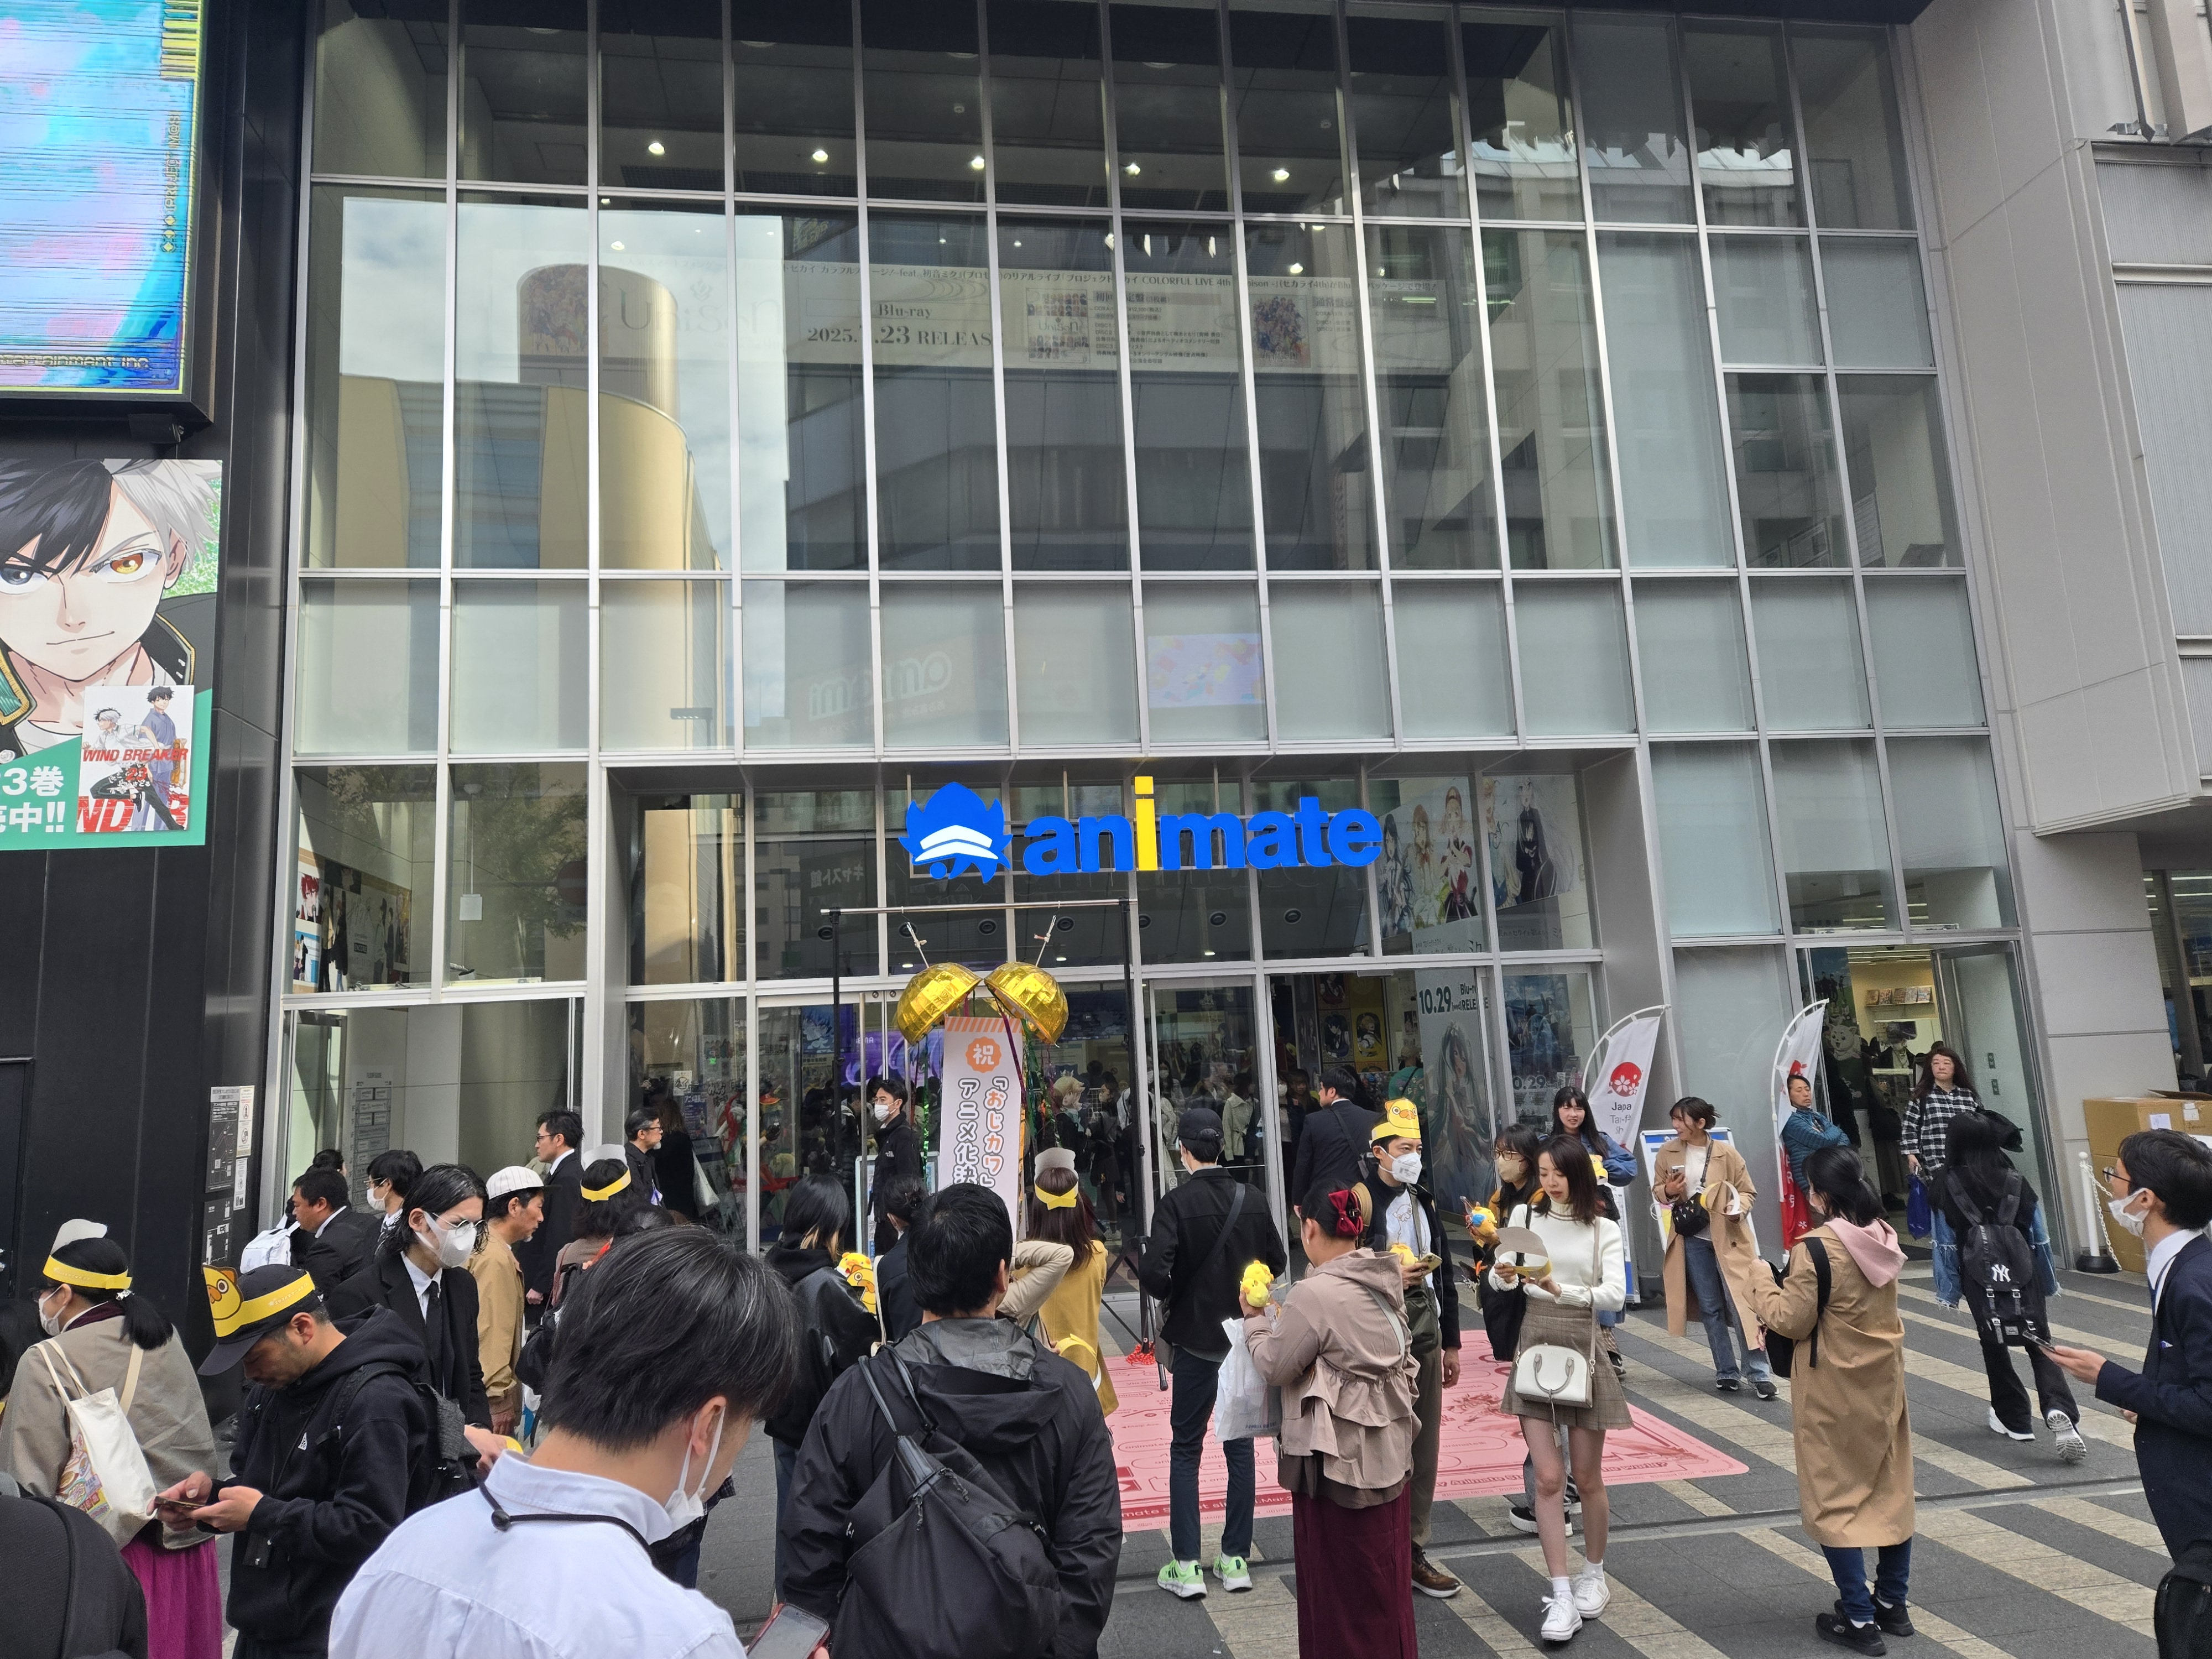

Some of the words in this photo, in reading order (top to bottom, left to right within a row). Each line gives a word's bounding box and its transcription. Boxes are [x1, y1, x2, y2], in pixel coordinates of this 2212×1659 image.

[1142, 276, 1193, 286] COLORFUL
[1195, 277, 1214, 286] LIVE
[878, 304, 932, 319] Blu-ray
[807, 325, 911, 344] 2025..23
[917, 330, 1005, 347] RELEAS
[82, 749, 120, 762] WIND
[122, 748, 189, 762] BREAKER
[1023, 776, 1383, 876] animate
[1460, 983, 1477, 995] Blu-r
[1419, 986, 1452, 1014] 10.29
[1462, 997, 1489, 1011] RELEE
[973, 1044, 994, 1065] 祝
[1512, 1076, 1546, 1090] 0.29
[1611, 1102, 1632, 1113] Japa
[953, 1078, 980, 1185] アニメ化決
[1991, 1264, 2011, 1282] NY
